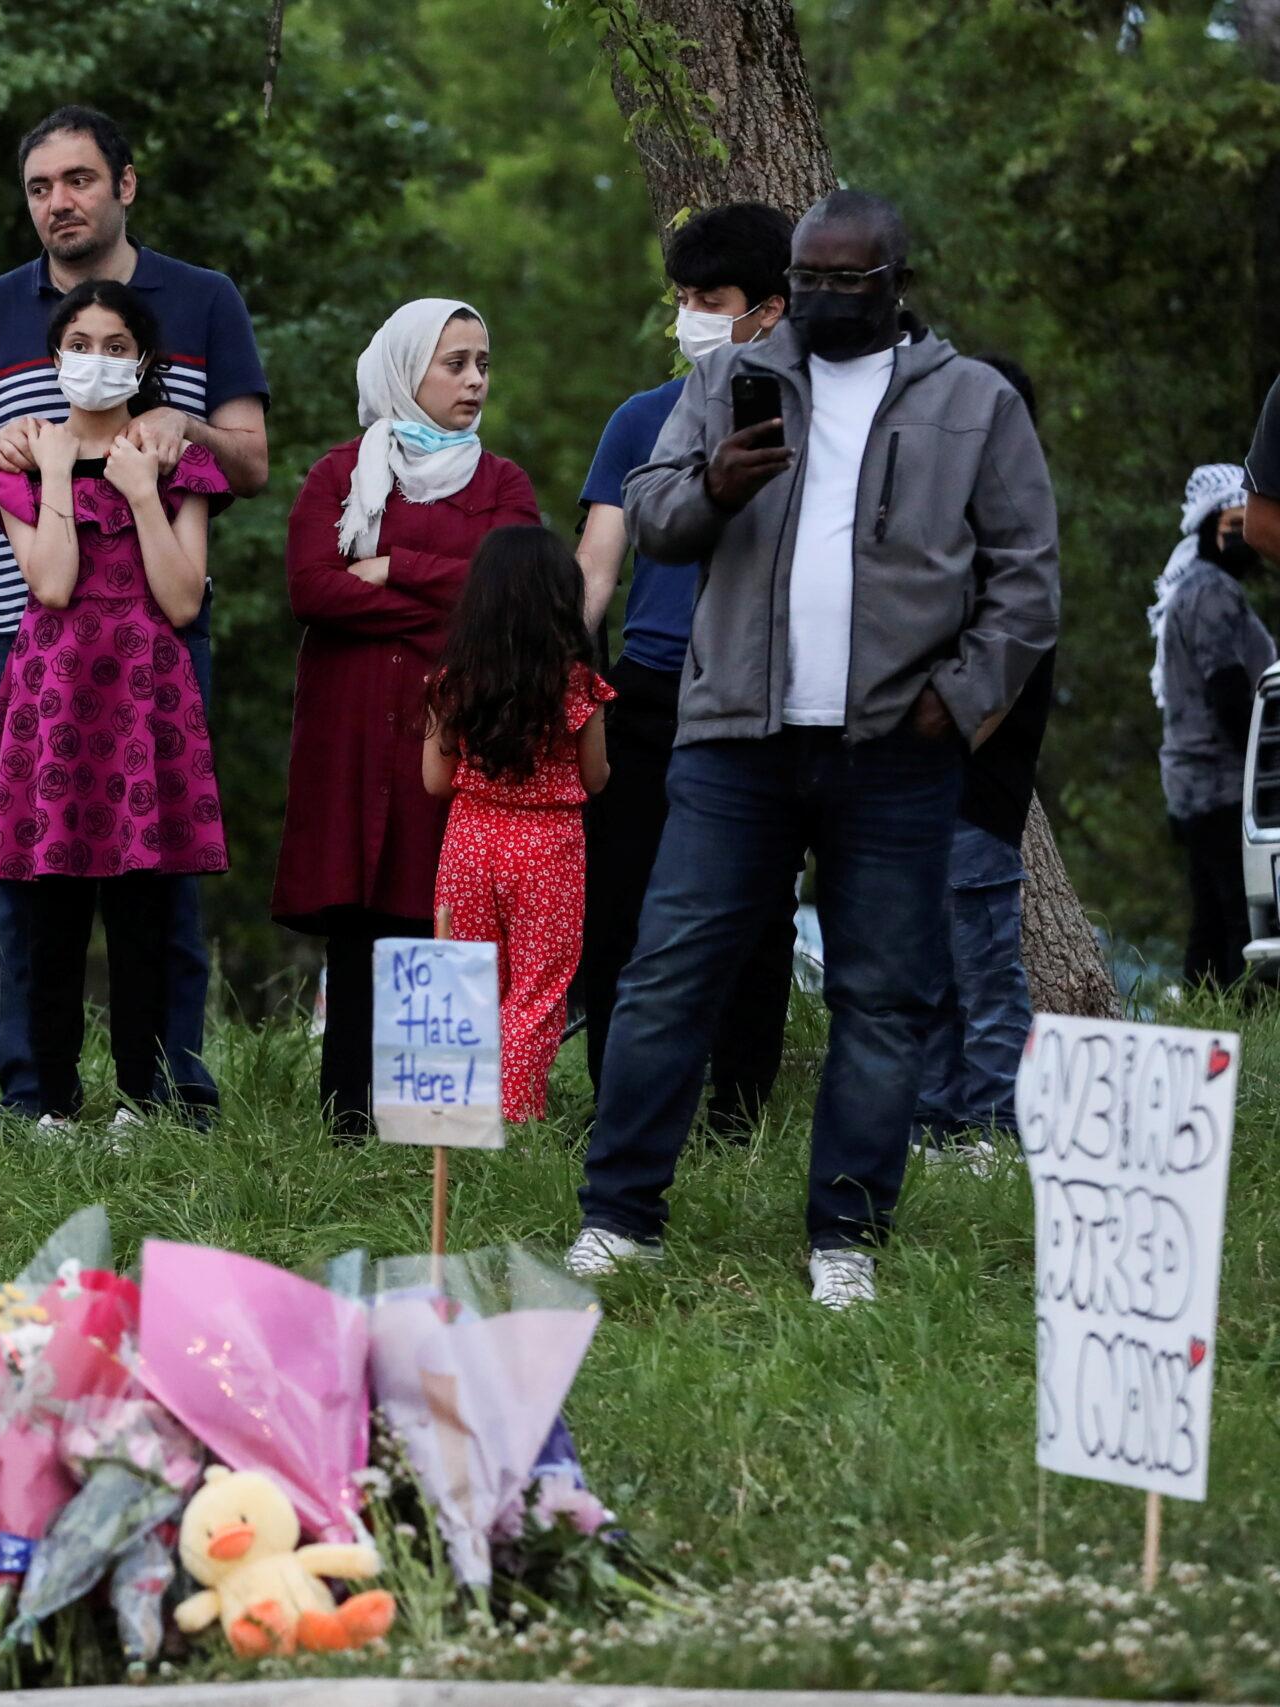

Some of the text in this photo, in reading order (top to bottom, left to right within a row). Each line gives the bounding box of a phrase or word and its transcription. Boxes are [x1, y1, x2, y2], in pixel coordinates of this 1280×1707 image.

[393, 946, 432, 992] No
[396, 992, 481, 1047] Hate
[1038, 1174, 1197, 1323] ATRED
